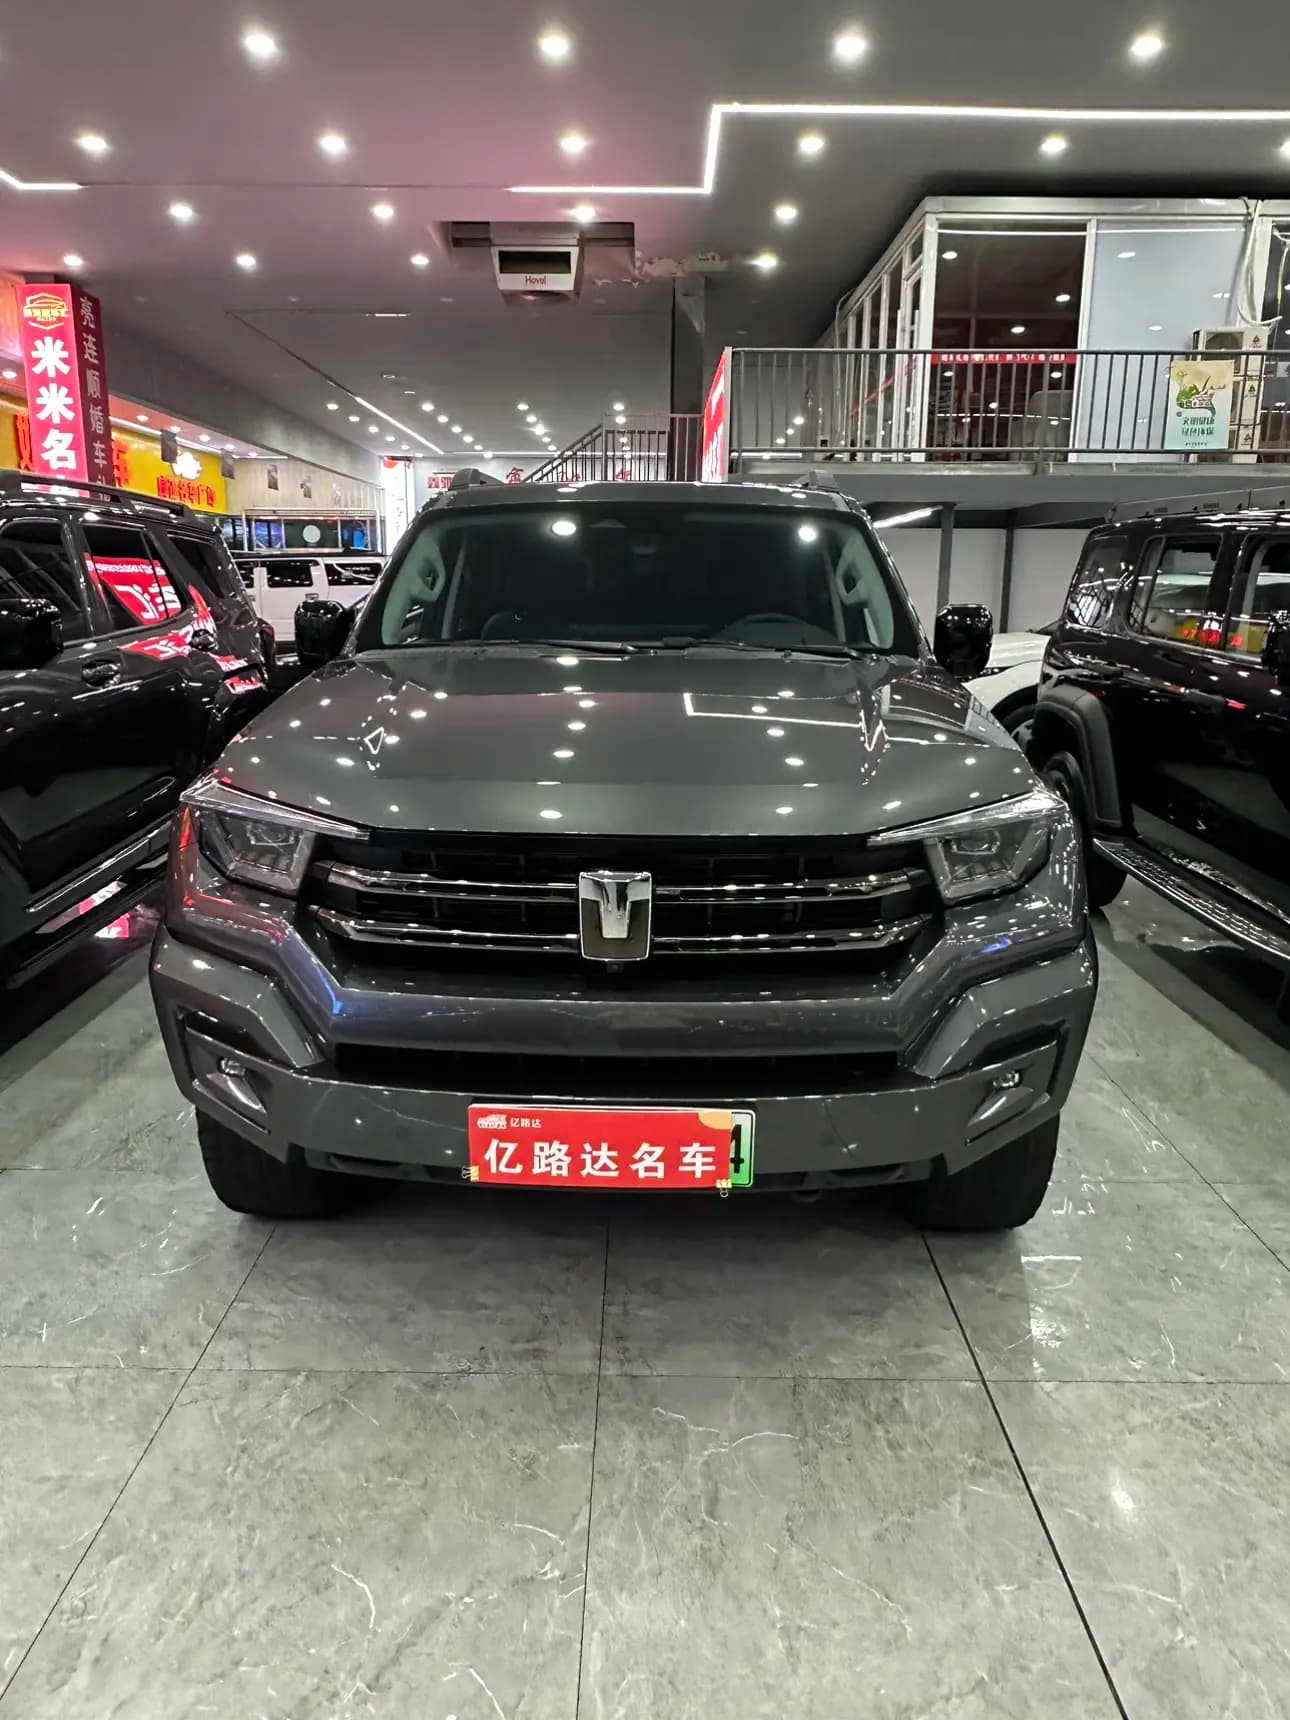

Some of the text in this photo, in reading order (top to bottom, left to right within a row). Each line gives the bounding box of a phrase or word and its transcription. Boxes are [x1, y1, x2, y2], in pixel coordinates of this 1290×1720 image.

[31, 336, 77, 479] 米米名
[510, 1117, 542, 1129] 亿路达
[484, 1138, 716, 1180] 亿路达名车
